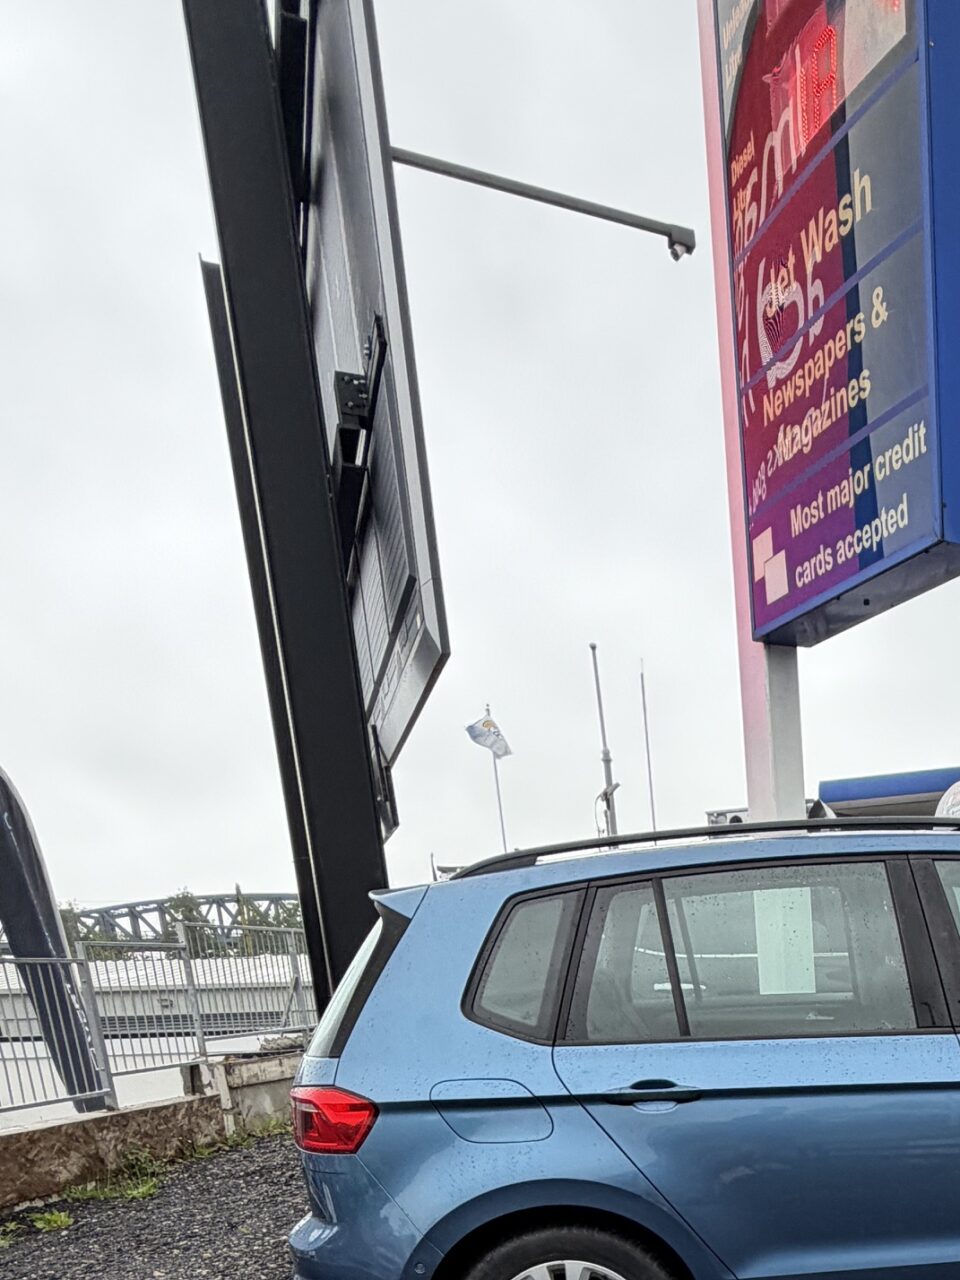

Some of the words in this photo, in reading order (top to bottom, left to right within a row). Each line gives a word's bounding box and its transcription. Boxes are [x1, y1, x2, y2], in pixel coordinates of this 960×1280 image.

[731, 129, 755, 187] Diesel
[766, 244, 797, 318] Jet
[800, 168, 872, 269] Wash
[763, 311, 866, 427] Newspapers
[871, 286, 888, 329] &
[777, 368, 872, 466] Magazines
[789, 489, 825, 539] Most
[826, 463, 871, 514] major
[874, 419, 928, 481] credit
[795, 544, 833, 588] cards
[836, 492, 909, 566] accepted
